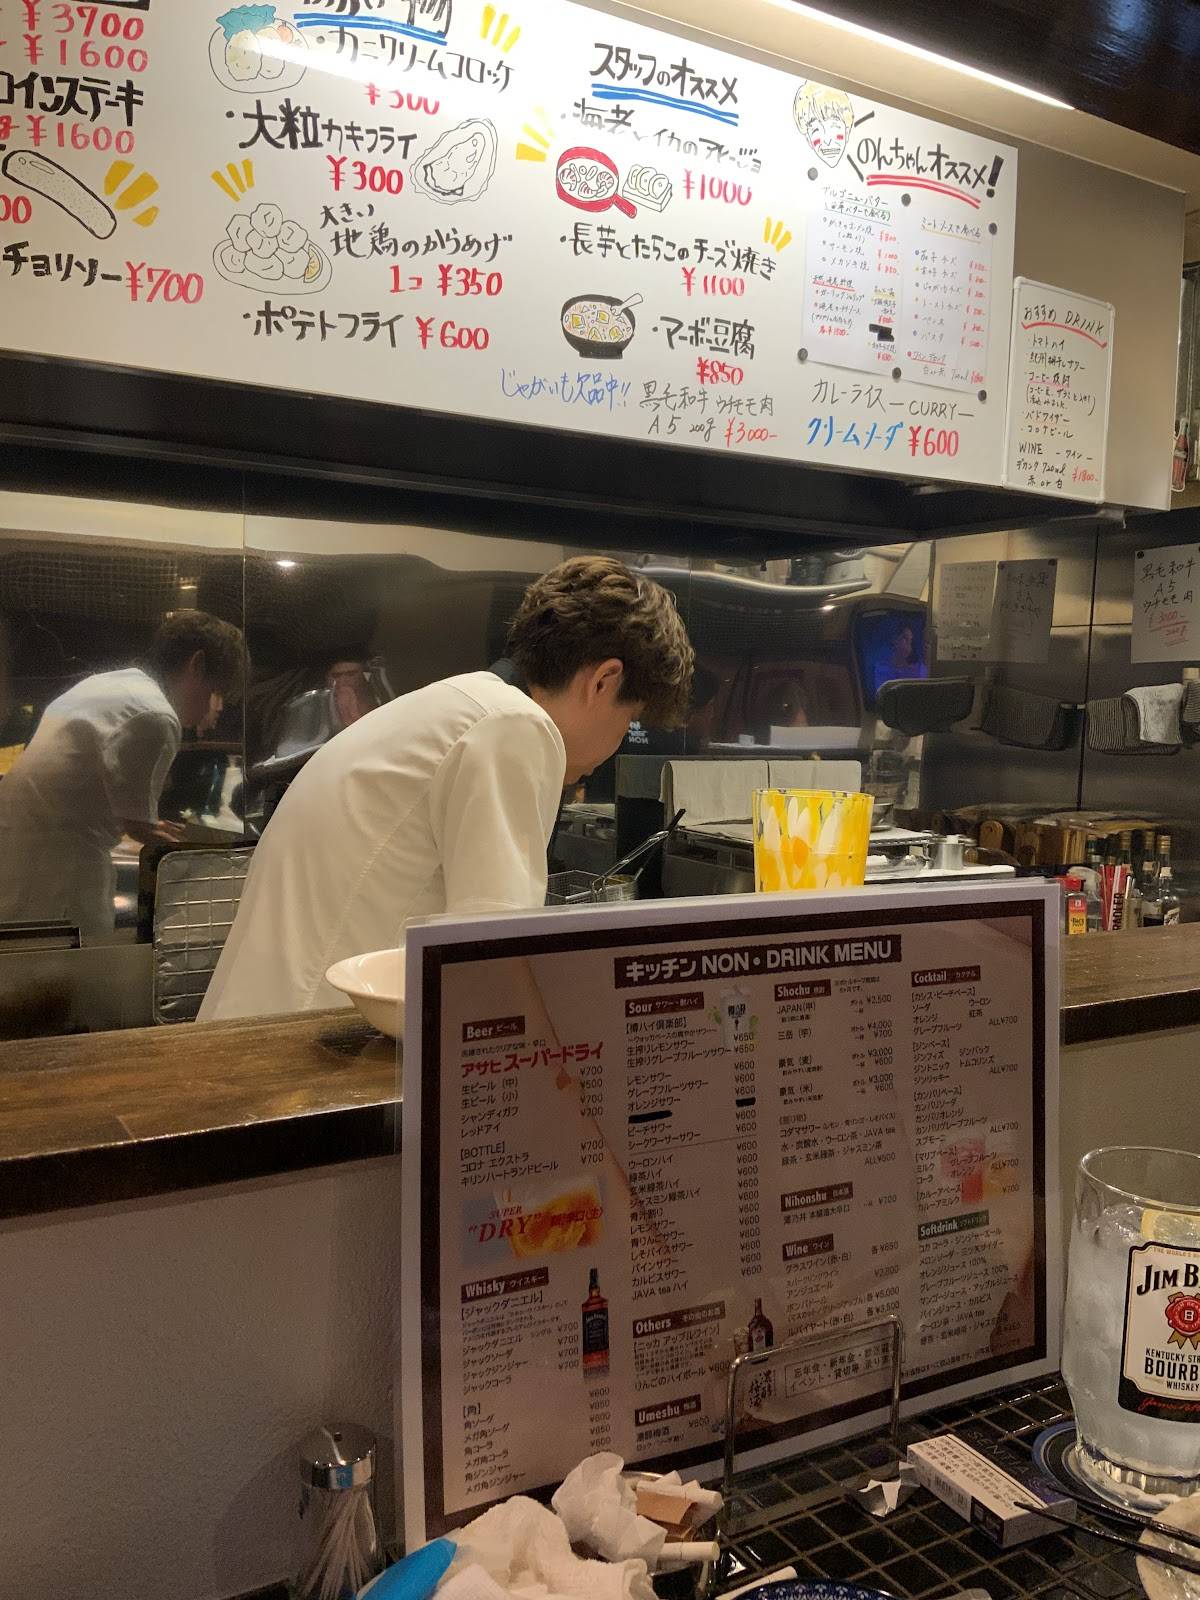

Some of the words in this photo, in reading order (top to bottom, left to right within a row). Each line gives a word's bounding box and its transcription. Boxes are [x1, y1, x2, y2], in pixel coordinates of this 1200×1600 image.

[22, 0, 145, 41] ¥3700
[22, 34, 148, 72] ¥1600
[590, 43, 738, 104] スタッフのオススメ
[26, 114, 135, 153] ¥1600
[326, 155, 403, 194] ¥300
[320, 203, 375, 229] 大きい
[126, 261, 203, 304] ¥700
[438, 264, 503, 296] ¥350
[681, 267, 745, 296] ¥1100
[253, 300, 404, 348] ポテトフライ
[416, 316, 489, 350] ¥600
[1065, 310, 1104, 336] DRINK
[696, 357, 744, 385] ¥850
[812, 378, 886, 413] カレーライス
[808, 415, 903, 450] クリームソーダ
[909, 424, 960, 458] ¥600
[1018, 441, 1043, 455] WINE
[626, 960, 697, 982] キッチン
[702, 951, 750, 975] NON
[766, 945, 830, 969] DRINK
[835, 940, 892, 963] MENU
[914, 970, 947, 984] Cocktail
[777, 984, 811, 998] Shochu
[629, 1001, 653, 1014] Sour
[466, 1025, 493, 1039] Beer
[462, 1058, 501, 1078] アサヒ
[504, 1041, 603, 1072] スーパードライ
[581, 1140, 604, 1151] ¥700
[581, 1152, 604, 1164] ¥700
[784, 1190, 828, 1209] Nihonshu
[920, 1219, 959, 1238] Softdrink
[785, 1243, 809, 1258] Wine
[465, 1279, 506, 1298] Whisky
[1136, 1264, 1179, 1296] JIM
[635, 1318, 672, 1335] Others
[1145, 1347, 1185, 1363] KENTUCKY
[1166, 1380, 1200, 1392] WHISKEY
[638, 1405, 680, 1424] Umeshu
